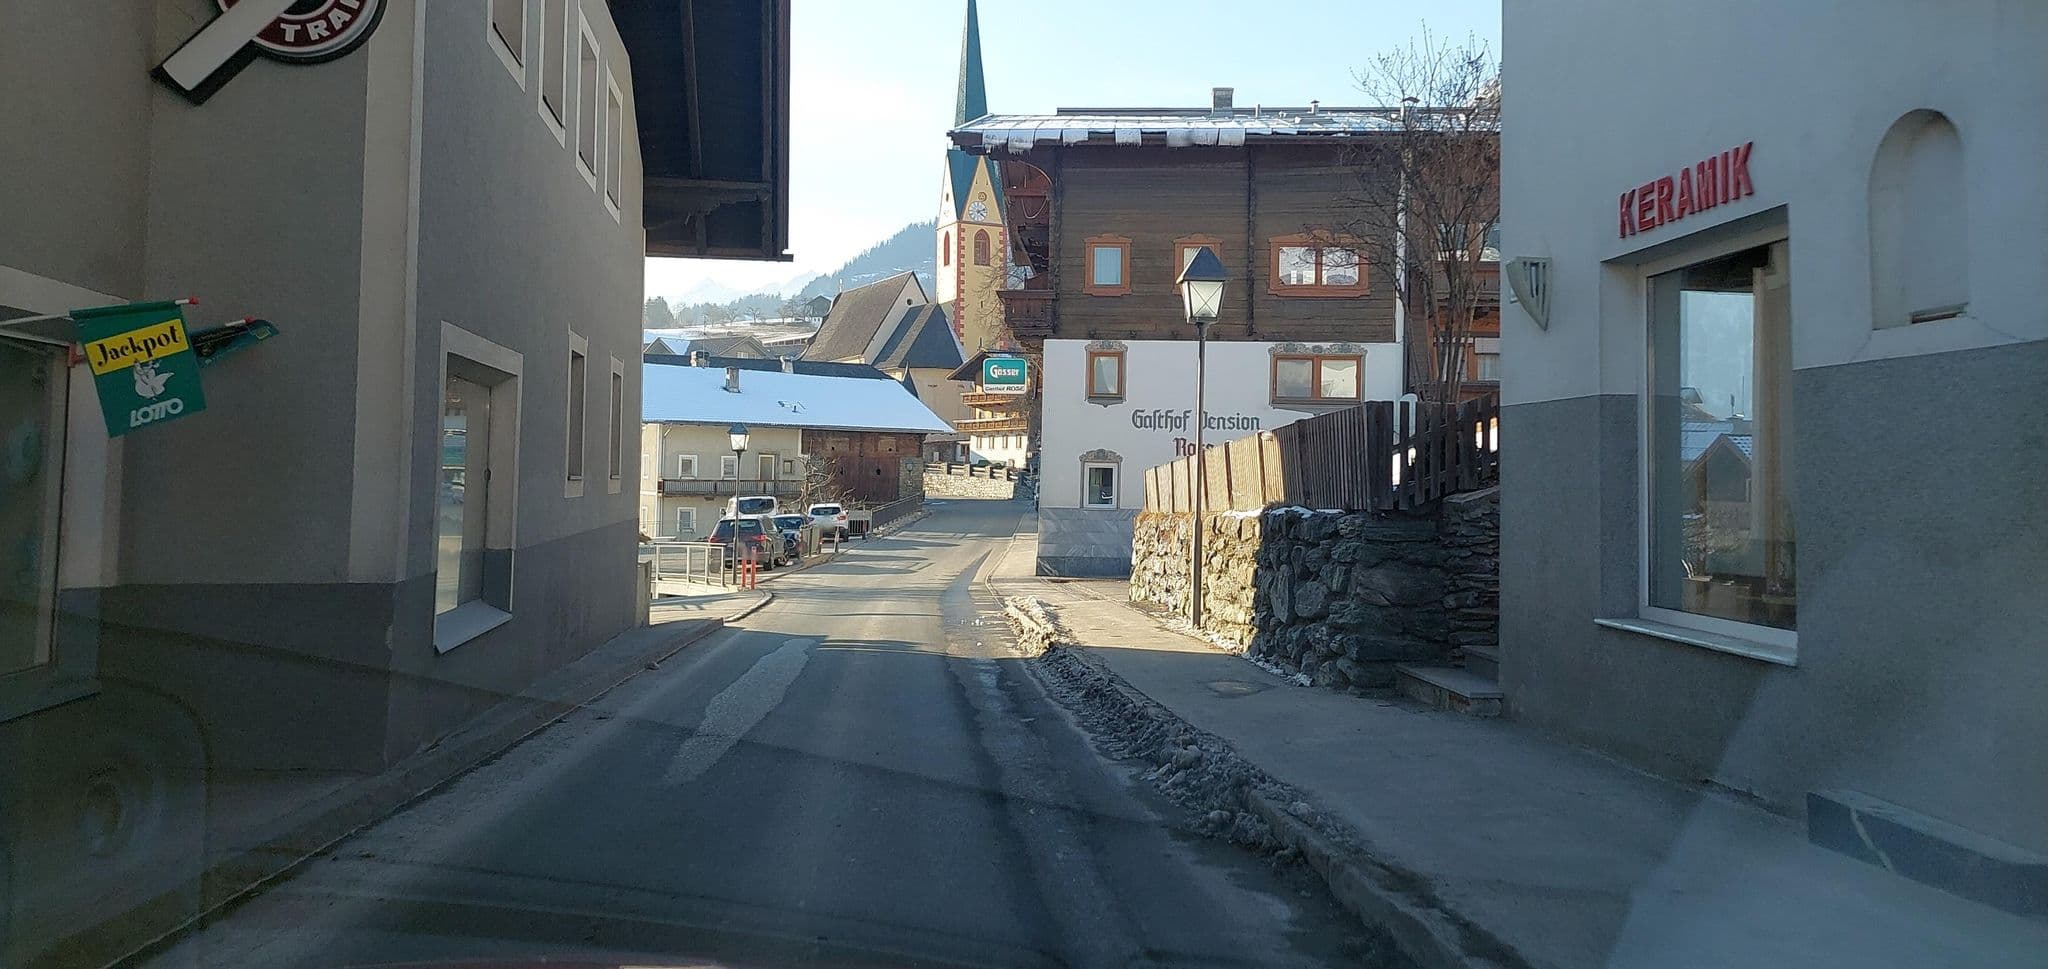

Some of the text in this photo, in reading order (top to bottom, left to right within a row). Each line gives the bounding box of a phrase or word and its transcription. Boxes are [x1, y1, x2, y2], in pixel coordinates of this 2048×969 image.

[1619, 141, 1754, 238] KERAMIK
[97, 325, 180, 366] Jackpot
[129, 398, 184, 428] LOTTO
